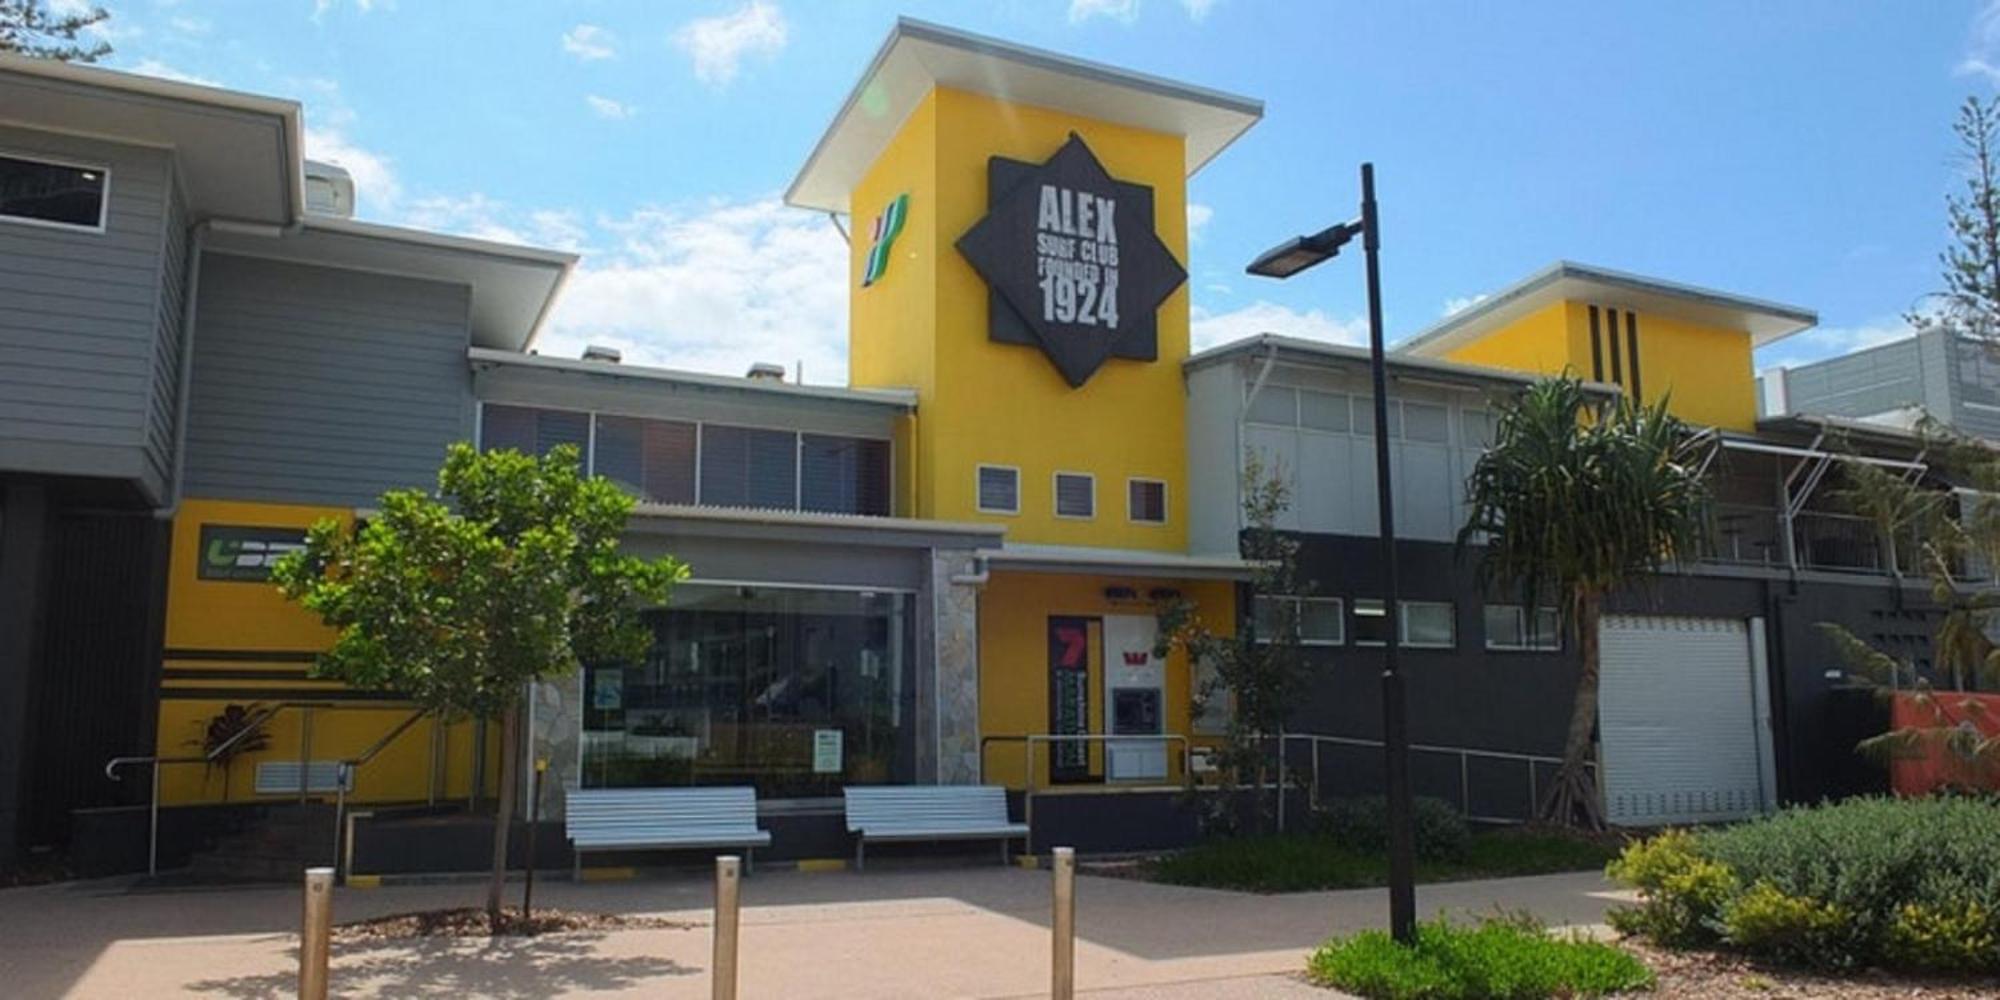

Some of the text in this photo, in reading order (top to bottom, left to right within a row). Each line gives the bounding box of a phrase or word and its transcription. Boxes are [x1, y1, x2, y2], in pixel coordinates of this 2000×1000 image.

[1038, 185, 1117, 244] ALEX
[1037, 233, 1119, 267] SURF CLUB
[1037, 257, 1119, 288] FOUNDED IN
[1039, 275, 1119, 329] 1924
